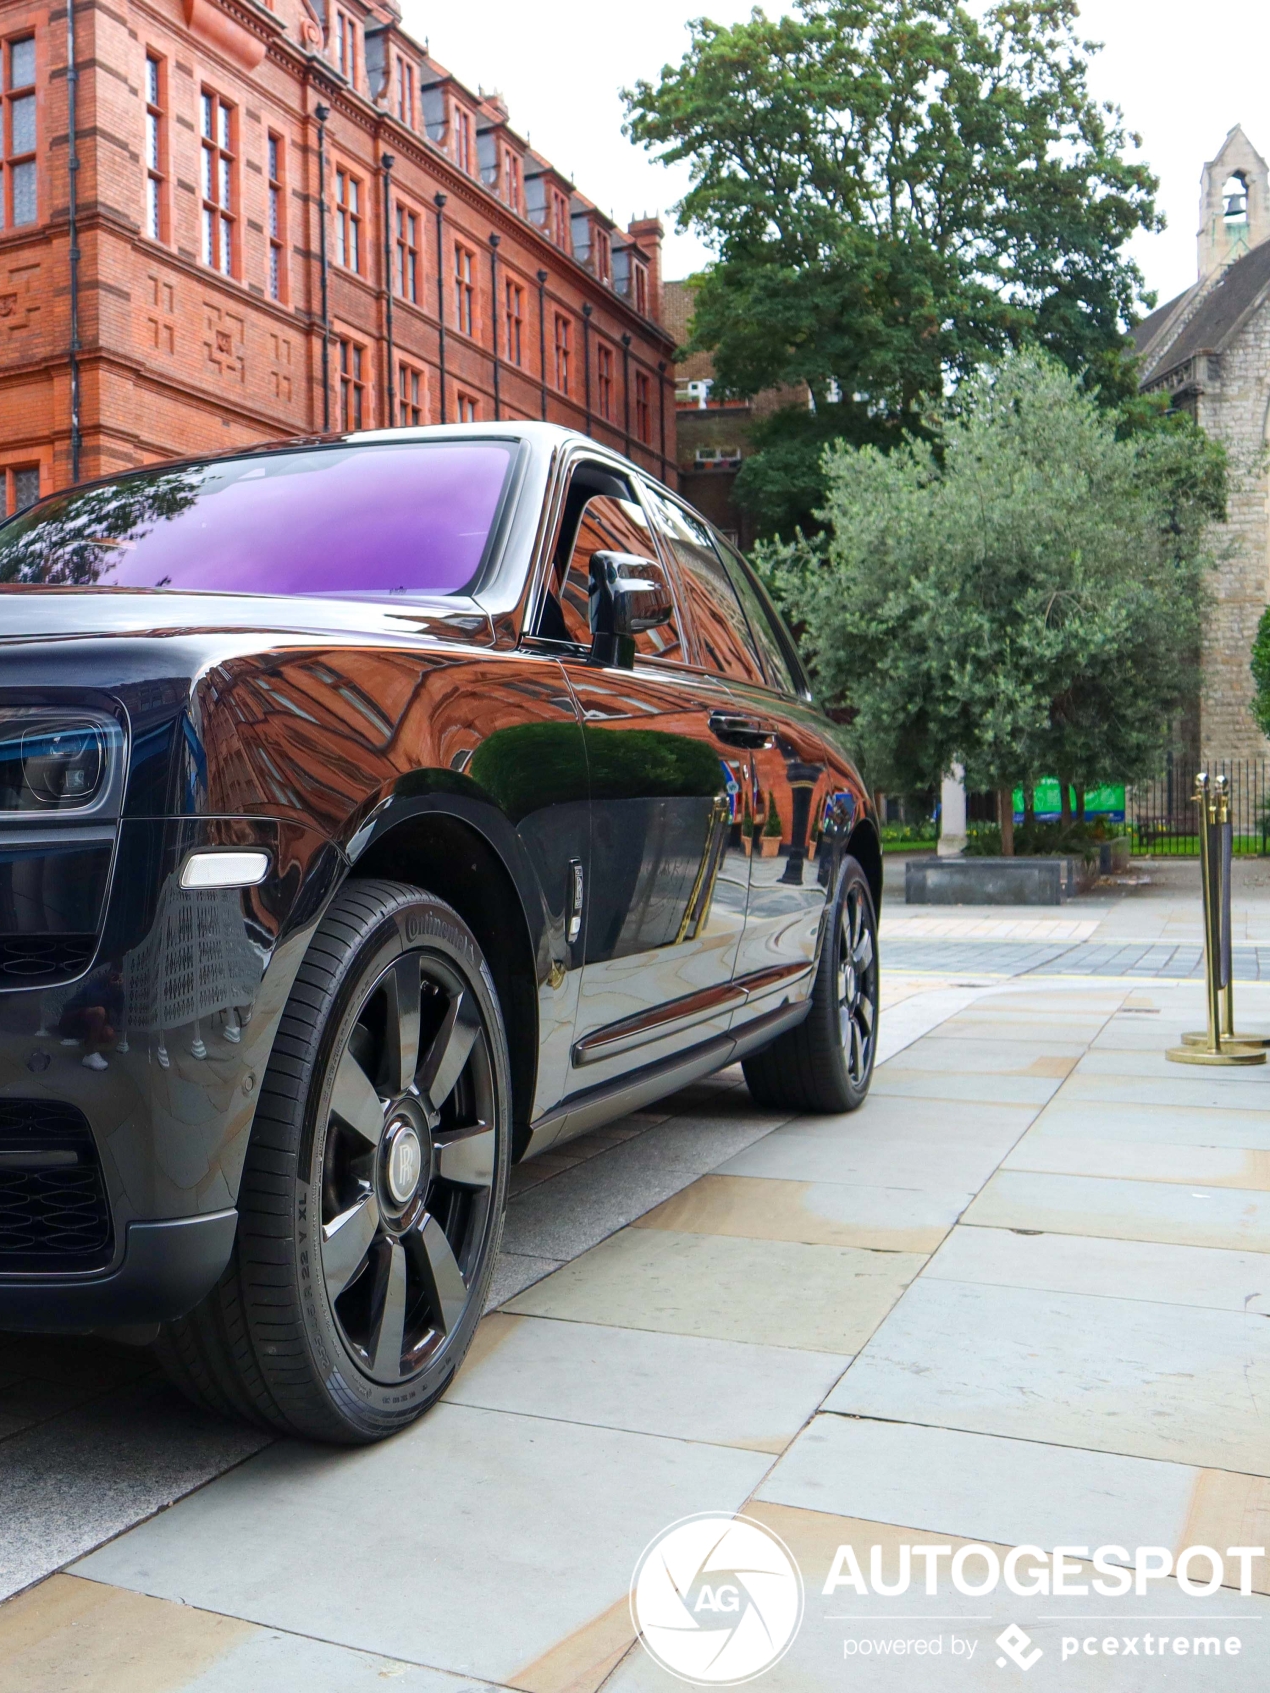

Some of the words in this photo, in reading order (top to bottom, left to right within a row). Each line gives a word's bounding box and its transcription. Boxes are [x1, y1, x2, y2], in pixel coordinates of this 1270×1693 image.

[405, 911, 468, 955] Continental
[298, 1192, 307, 1222] XL
[300, 1250, 310, 1278] 22
